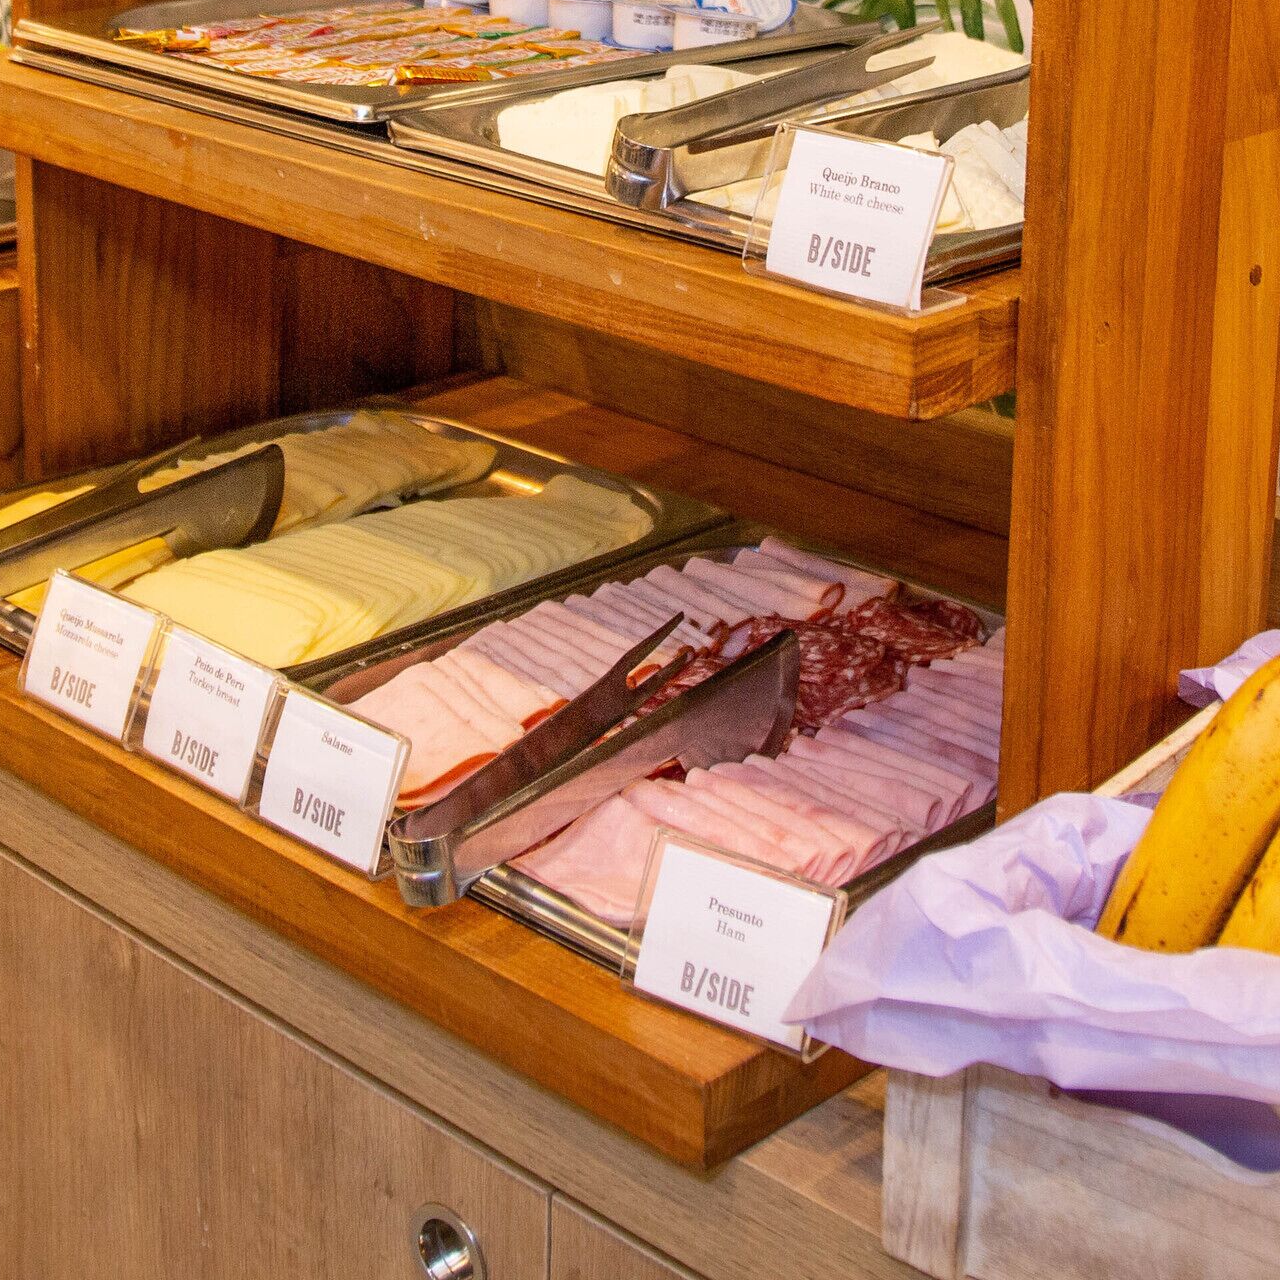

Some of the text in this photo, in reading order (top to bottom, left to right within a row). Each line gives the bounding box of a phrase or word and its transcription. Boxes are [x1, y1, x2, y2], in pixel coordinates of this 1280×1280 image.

[822, 167, 901, 195] Queijo Branco
[810, 182, 904, 215] White soft cheese
[807, 233, 876, 277] B/SIDE
[60, 608, 84, 627] Queijo
[94, 640, 119, 659] cheese
[50, 666, 96, 709] B/SIDE
[188, 670, 241, 708] Turkey breast
[194, 656, 246, 692] Peito de Peru
[171, 729, 219, 778] B/SIDE
[321, 731, 354, 756] Salame
[292, 787, 346, 838] B/SIDE
[708, 896, 764, 928] Presunto
[716, 919, 747, 943] Ham
[680, 961, 755, 1018] B/SIDE
